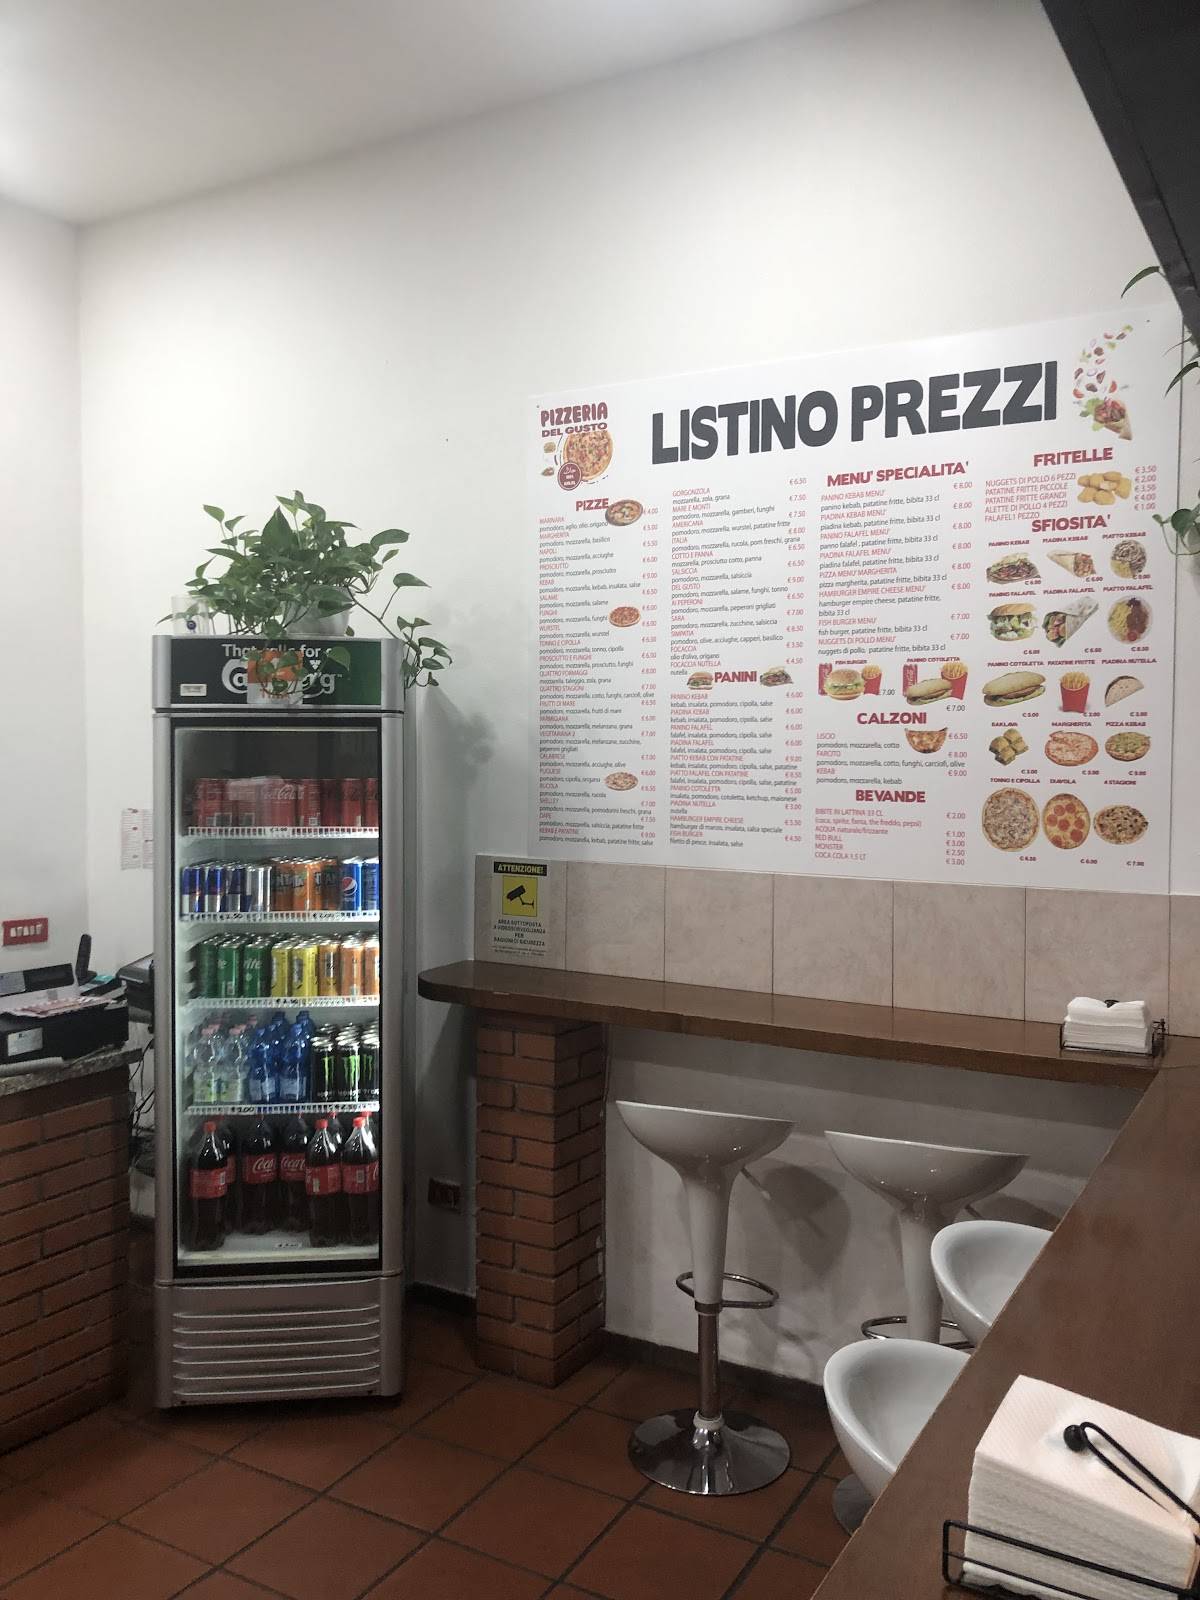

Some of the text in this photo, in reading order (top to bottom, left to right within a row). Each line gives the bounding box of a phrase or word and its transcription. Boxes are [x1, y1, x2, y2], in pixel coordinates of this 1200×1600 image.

[541, 402, 608, 427] PIZZERIA
[652, 360, 1058, 465] LISTINO PREZZI
[542, 423, 608, 438] DEL GUSTO
[1033, 447, 1114, 467] FRITELLE
[827, 461, 969, 487] MENU' SPECIALITA'
[986, 478, 1018, 488] NUGGETS
[1019, 477, 1026, 485] DI
[1028, 475, 1049, 484] POLLO
[1057, 473, 1076, 481] PEZZI
[673, 488, 710, 497] GORGONZOLA
[986, 483, 1068, 496] PATATINE FRITTE PICCOLE
[821, 494, 843, 502] PANINO
[845, 492, 864, 500] KEBAB
[576, 498, 609, 511] PIZZE
[757, 505, 775, 514] funghi
[821, 503, 841, 512] panino
[863, 499, 887, 509] patatine
[906, 496, 924, 504] bibita
[985, 505, 1009, 513] ALETTE
[1020, 502, 1041, 511] POLLO
[1049, 500, 1068, 508] PEZZI
[1018, 511, 1040, 520] PEZZO
[1032, 514, 1111, 532] SFIOSITA'
[858, 567, 897, 576] MARGHERITA
[819, 580, 834, 589] pizza
[870, 577, 895, 586] patatine
[819, 589, 856, 597] HAMBURGER
[858, 588, 880, 596] EMPIRE
[303, 643, 321, 657] for
[818, 647, 842, 656] nuggets
[869, 646, 893, 654] patatine
[714, 671, 757, 682] PANINI
[857, 712, 927, 725] CALZONI
[902, 760, 923, 768] funghi,
[856, 790, 926, 803] BEVANDE
[498, 864, 544, 873] ATTENZIONE!
